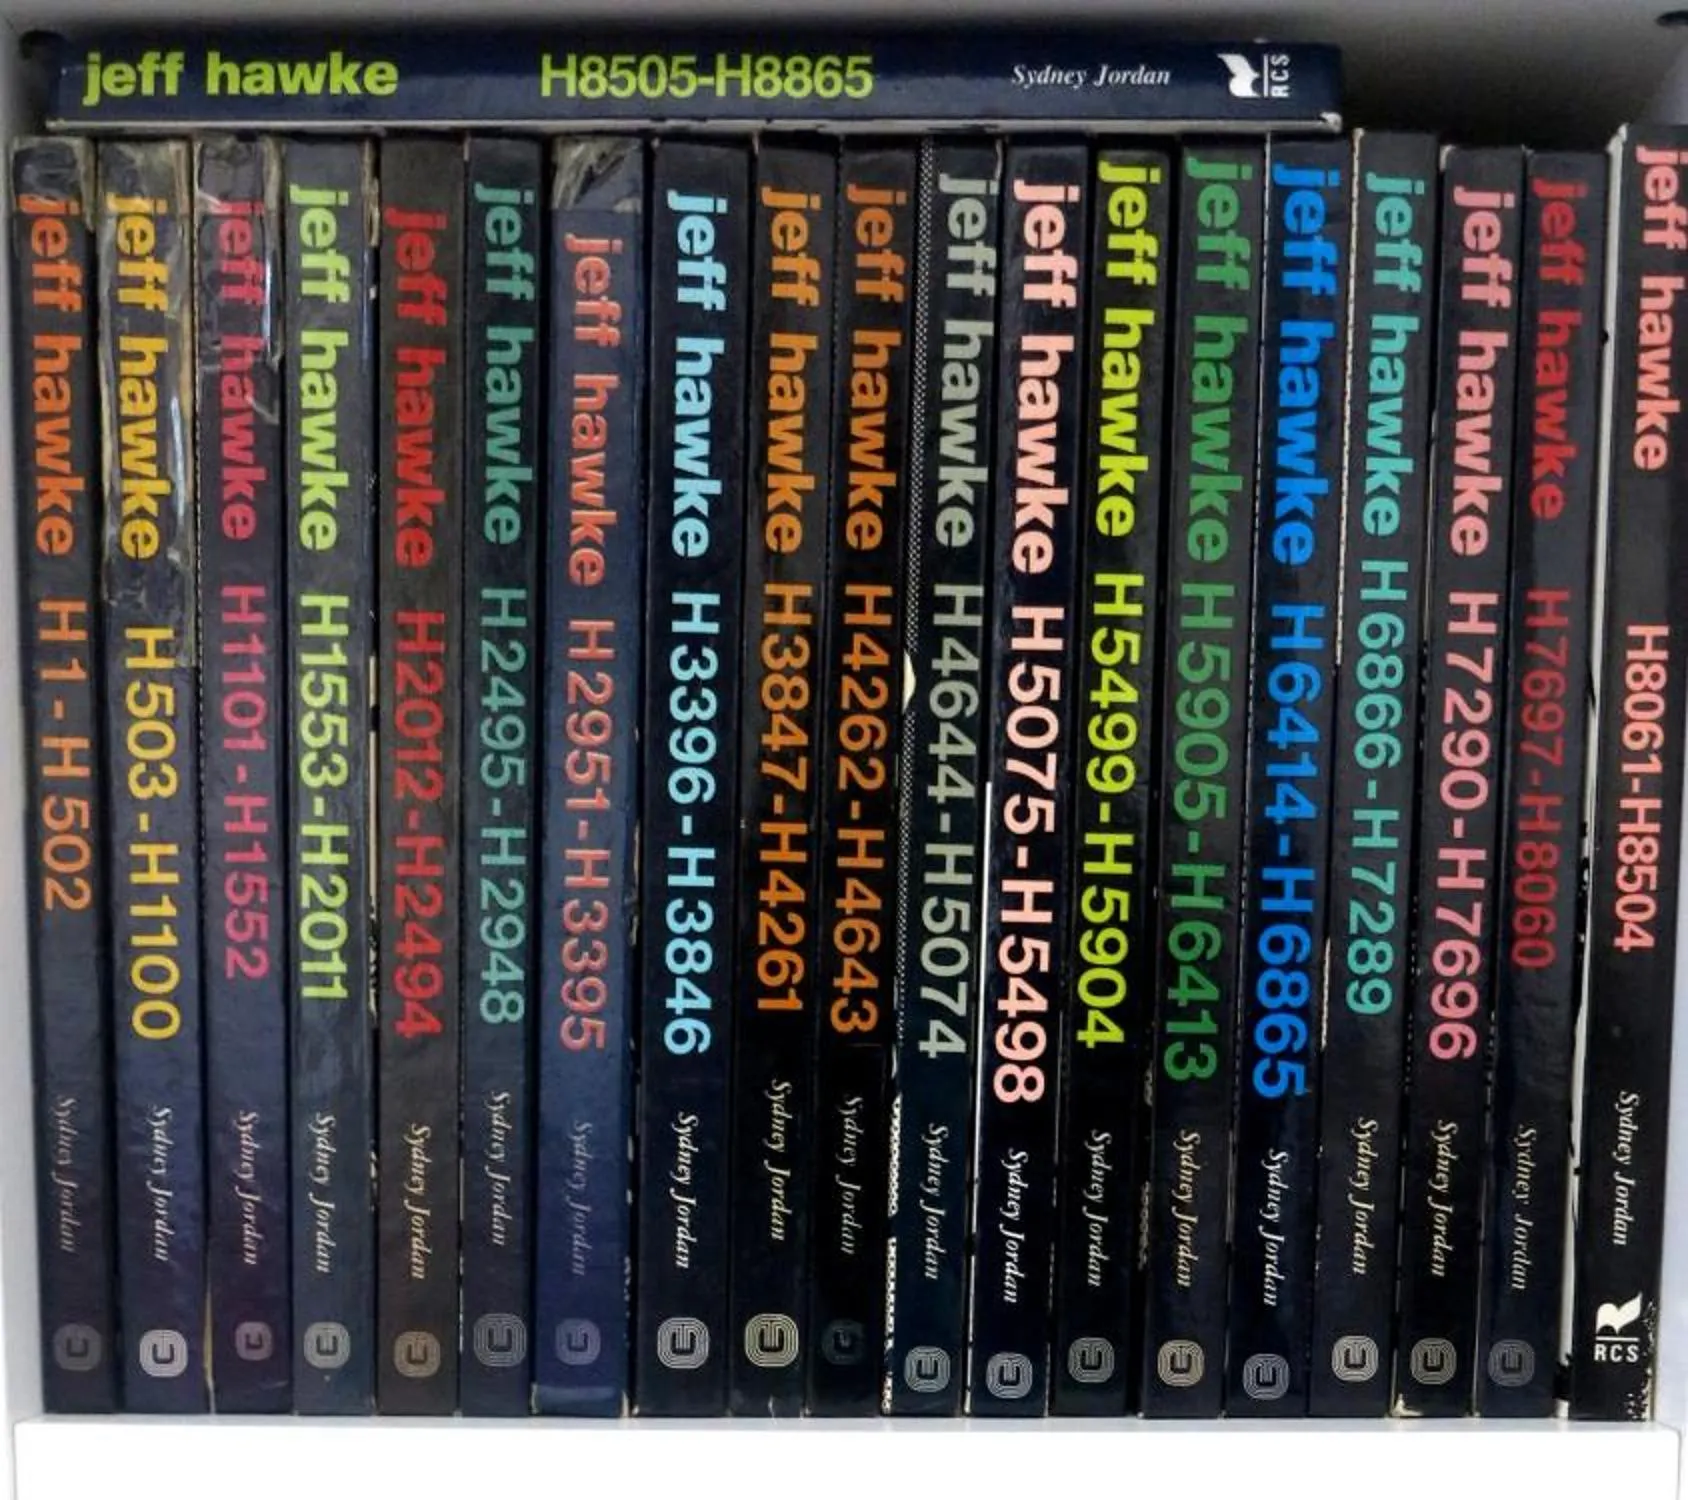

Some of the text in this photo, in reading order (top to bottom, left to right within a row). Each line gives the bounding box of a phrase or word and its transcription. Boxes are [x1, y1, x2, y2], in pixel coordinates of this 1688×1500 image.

[83, 51, 399, 107] jeff hawke
[541, 54, 872, 99] H8505-H8865
[1011, 63, 1171, 88] Sydney Jordan
[1270, 52, 1291, 98] RCS
[18, 193, 84, 556] jeff hawke
[105, 193, 171, 558] jeff hawke
[216, 198, 266, 540] jeff hawke
[290, 184, 350, 550] jeff hawke
[386, 207, 447, 567] jeff hawke
[474, 183, 534, 544] jeff hawke
[565, 233, 622, 584] jeff hawke
[668, 190, 727, 557] jeff hawke
[762, 187, 820, 552] jeff hawke
[846, 184, 906, 549] jeff hawke
[936, 173, 997, 546] jeff hawke
[1012, 179, 1079, 573] jeff hawke
[1096, 161, 1160, 536] jeff hawke
[1186, 156, 1253, 562] jeff hawke
[1273, 164, 1340, 564] jeff hawke
[1363, 172, 1424, 536] jeff hawke
[1451, 186, 1515, 555] jeff hawke
[1532, 179, 1588, 519] jeff hawke
[1634, 146, 1688, 469] jeff hawke
[126, 628, 180, 1038] H503-H1100
[222, 586, 268, 978] H1101-H1552
[300, 595, 349, 997] H1553-H2011
[394, 612, 444, 1038] H2012-H2494
[479, 589, 526, 1023] H2495-H2948
[561, 620, 614, 1049] H2951-H3395
[664, 593, 720, 1054] H3396-H3846
[758, 583, 813, 1009] H3847-H4261
[831, 585, 894, 1032] H4262-H4643
[919, 584, 983, 1059] H4644-H5074
[992, 606, 1064, 1102] H5075-H5498
[1077, 574, 1144, 1048] H5499-H5904
[1165, 583, 1235, 1080] H5905-H6413
[1254, 604, 1326, 1097] H6414-H6865
[1346, 560, 1408, 1013] H6866-H7289
[1429, 592, 1498, 1060] H7290-H7696
[1513, 588, 1571, 967] H7697-H8060
[1615, 625, 1668, 951] H8061-H8504
[50, 1095, 81, 1252] Sydney Jordan
[145, 1107, 176, 1261] Sydney Jordan
[233, 1111, 263, 1265] Sydney Jordan
[307, 1112, 337, 1273] Sydney Jordan
[403, 1123, 433, 1279] Sydney Jordan
[484, 1091, 513, 1246] Sydney Jordan
[565, 1119, 594, 1276] Sydney Jordan
[669, 1111, 699, 1269] Sydney Jordan
[763, 1079, 793, 1241] Sydney Jordan
[835, 1096, 864, 1255] Sydney Jordan
[919, 1123, 950, 1280] Sydney Jordan
[998, 1148, 1029, 1303] Sydney Jordan
[1081, 1129, 1113, 1287] Sydney Jordan
[1171, 1130, 1201, 1287] Sydney Jordan
[1258, 1148, 1290, 1307] Sydney Jordan
[1347, 1117, 1379, 1275] Sydney Jordan
[1427, 1119, 1458, 1277] Sydney Jordan
[1511, 1128, 1537, 1290] Sydney Jordan
[1612, 1090, 1640, 1246] Sydney Jordan
[1593, 1343, 1640, 1362] RCS
